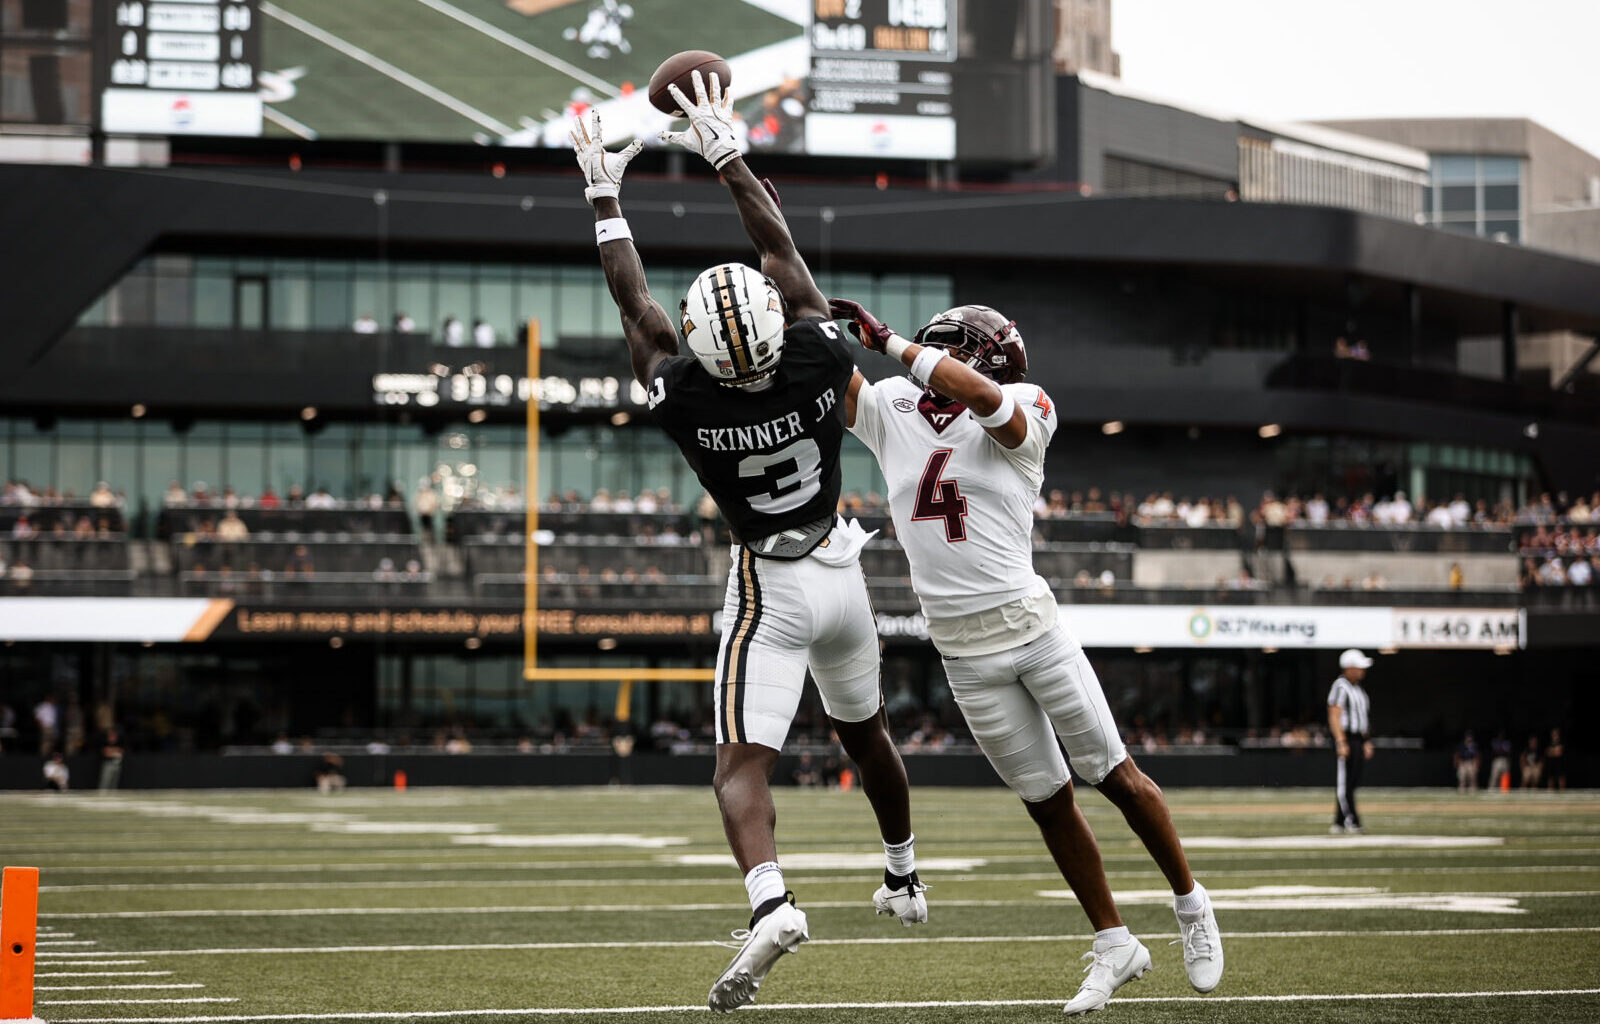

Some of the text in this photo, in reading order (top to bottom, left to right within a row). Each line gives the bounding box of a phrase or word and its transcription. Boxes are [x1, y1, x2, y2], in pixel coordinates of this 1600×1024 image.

[697, 387, 836, 451] SKINNER JR
[930, 413, 953, 426] VT
[1033, 388, 1052, 420] 4
[738, 438, 822, 514] 3
[911, 449, 968, 543] 4
[237, 608, 295, 633] Learn
[299, 612, 350, 633] more
[353, 609, 389, 633] and
[477, 613, 521, 638] your
[1480, 620, 1519, 637] AM
